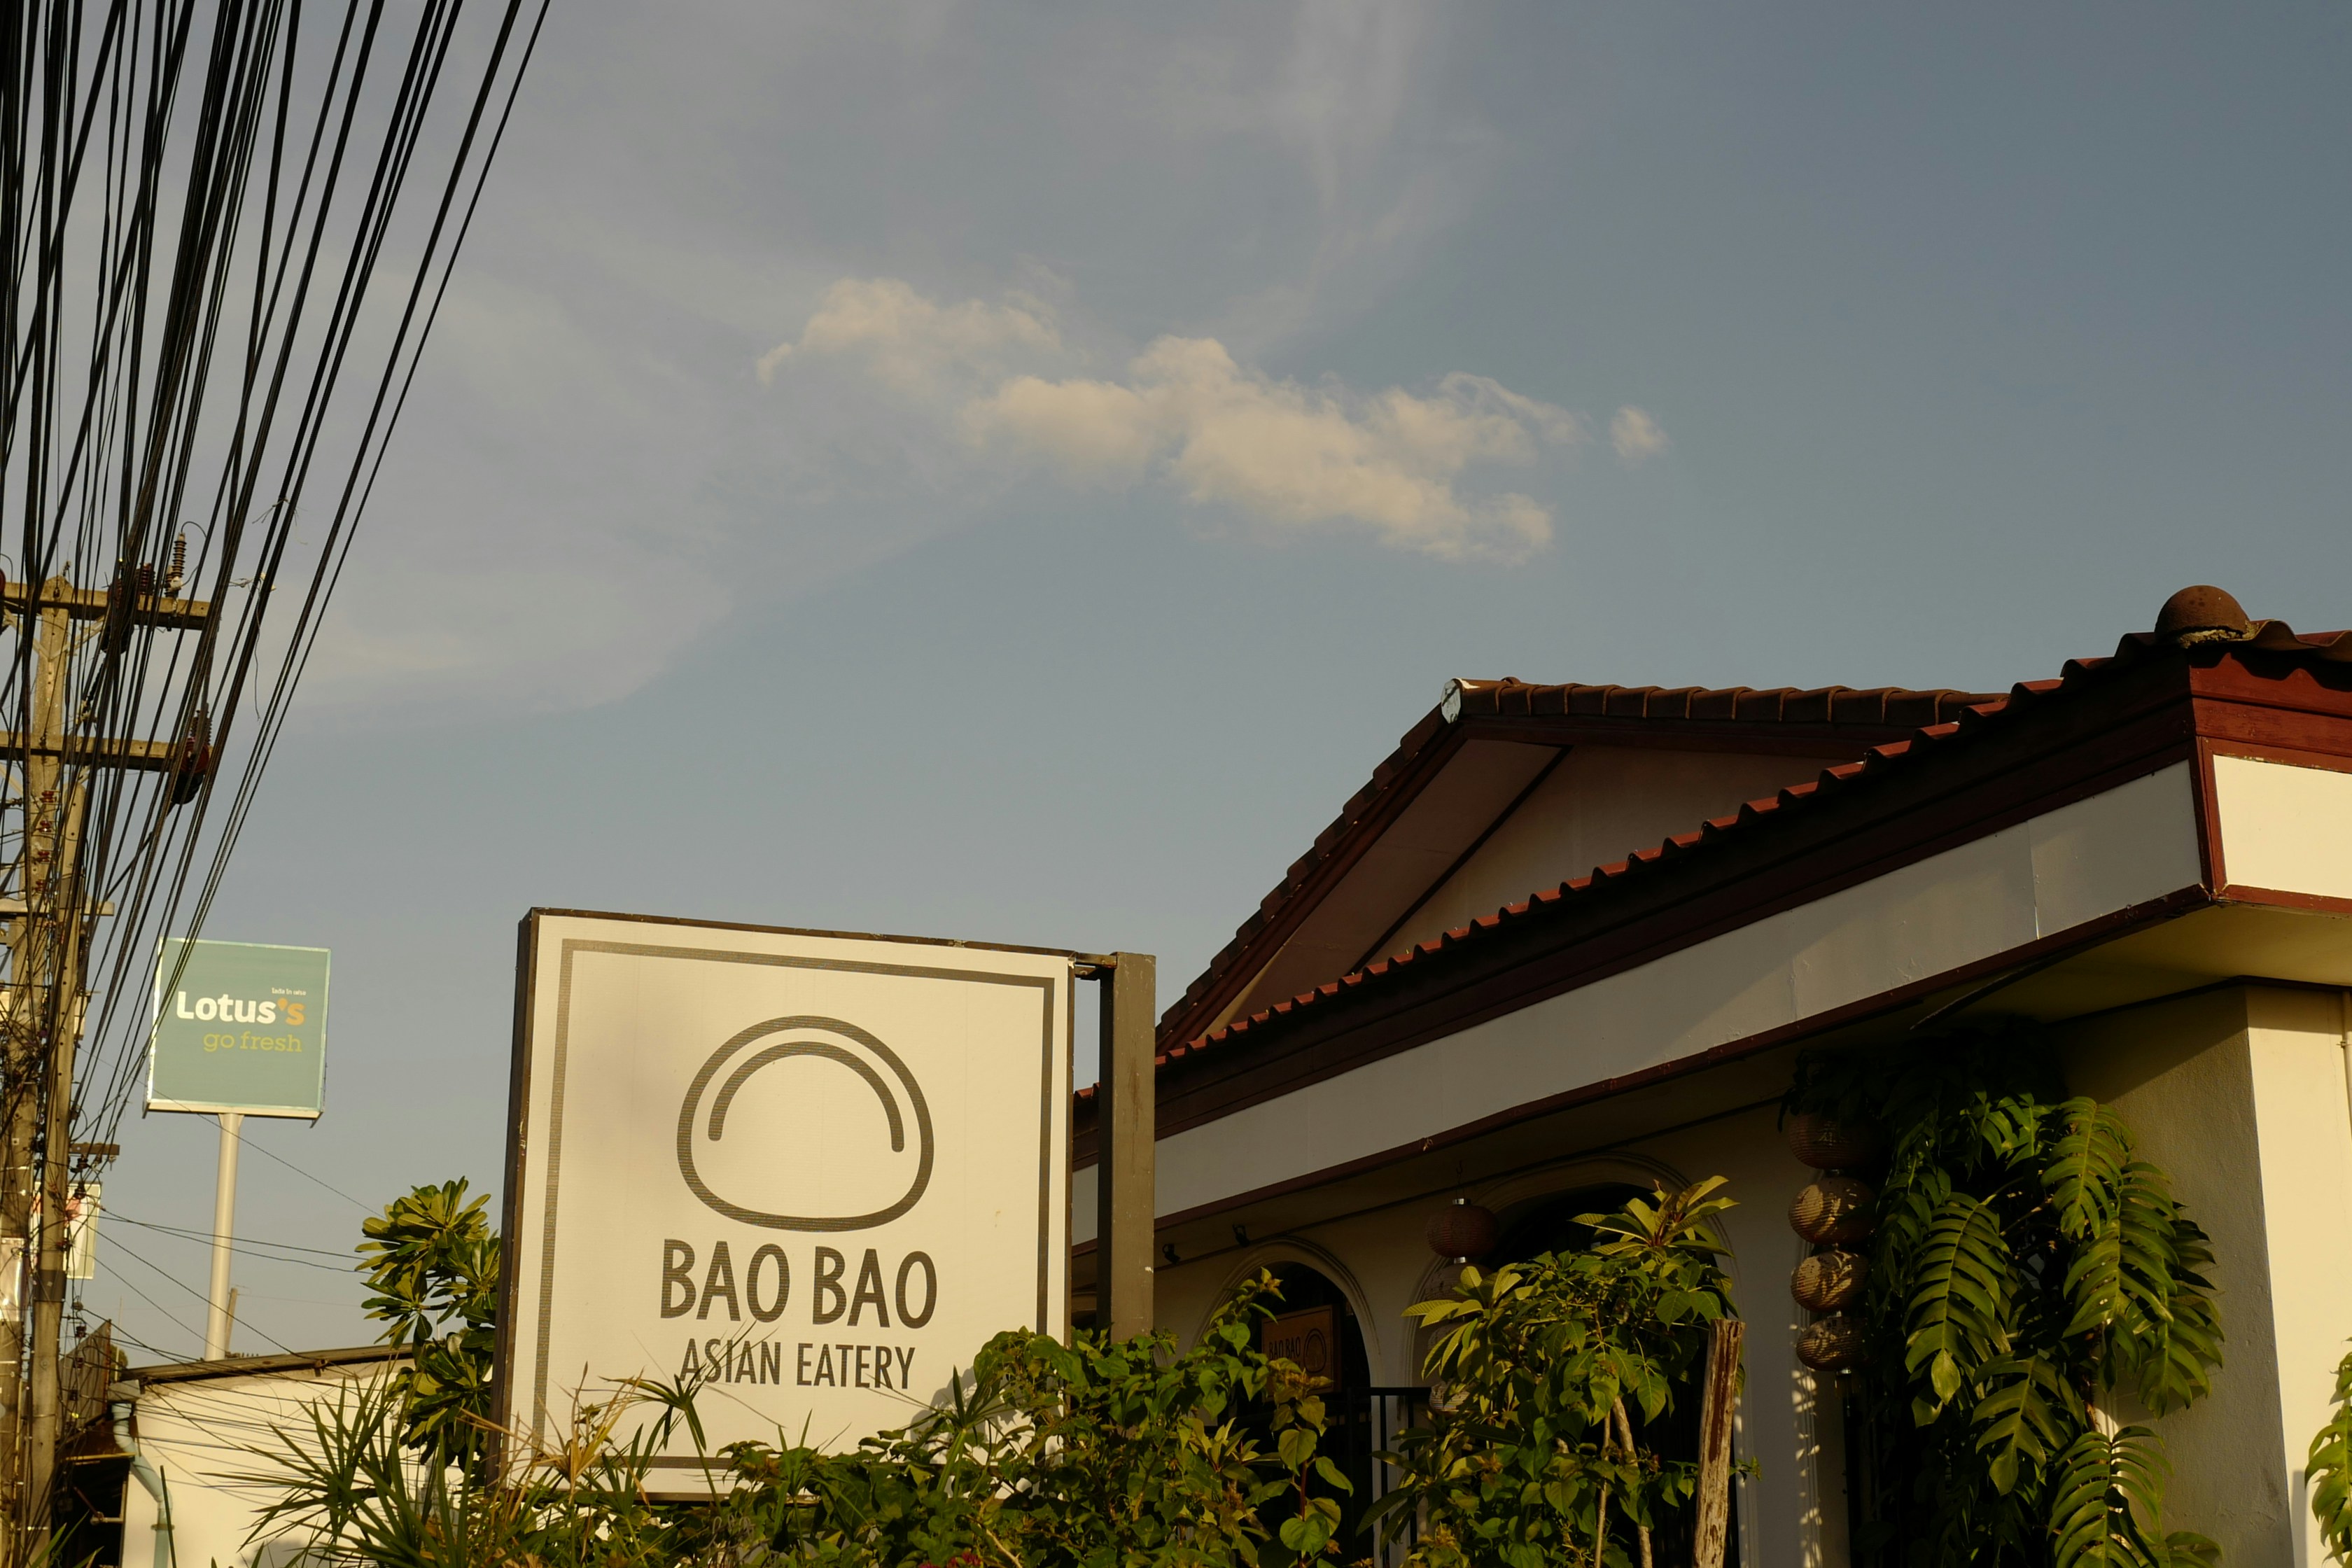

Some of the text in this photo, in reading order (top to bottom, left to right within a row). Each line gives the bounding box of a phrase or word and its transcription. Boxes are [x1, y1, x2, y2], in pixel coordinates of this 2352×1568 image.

[176, 991, 306, 1026] Lotus's
[203, 1030, 302, 1053] go fresh
[660, 1238, 937, 1329] BAO BAO
[680, 1338, 916, 1390] ASIAN EATERY
[1269, 1336, 1301, 1362] BAO BAO
